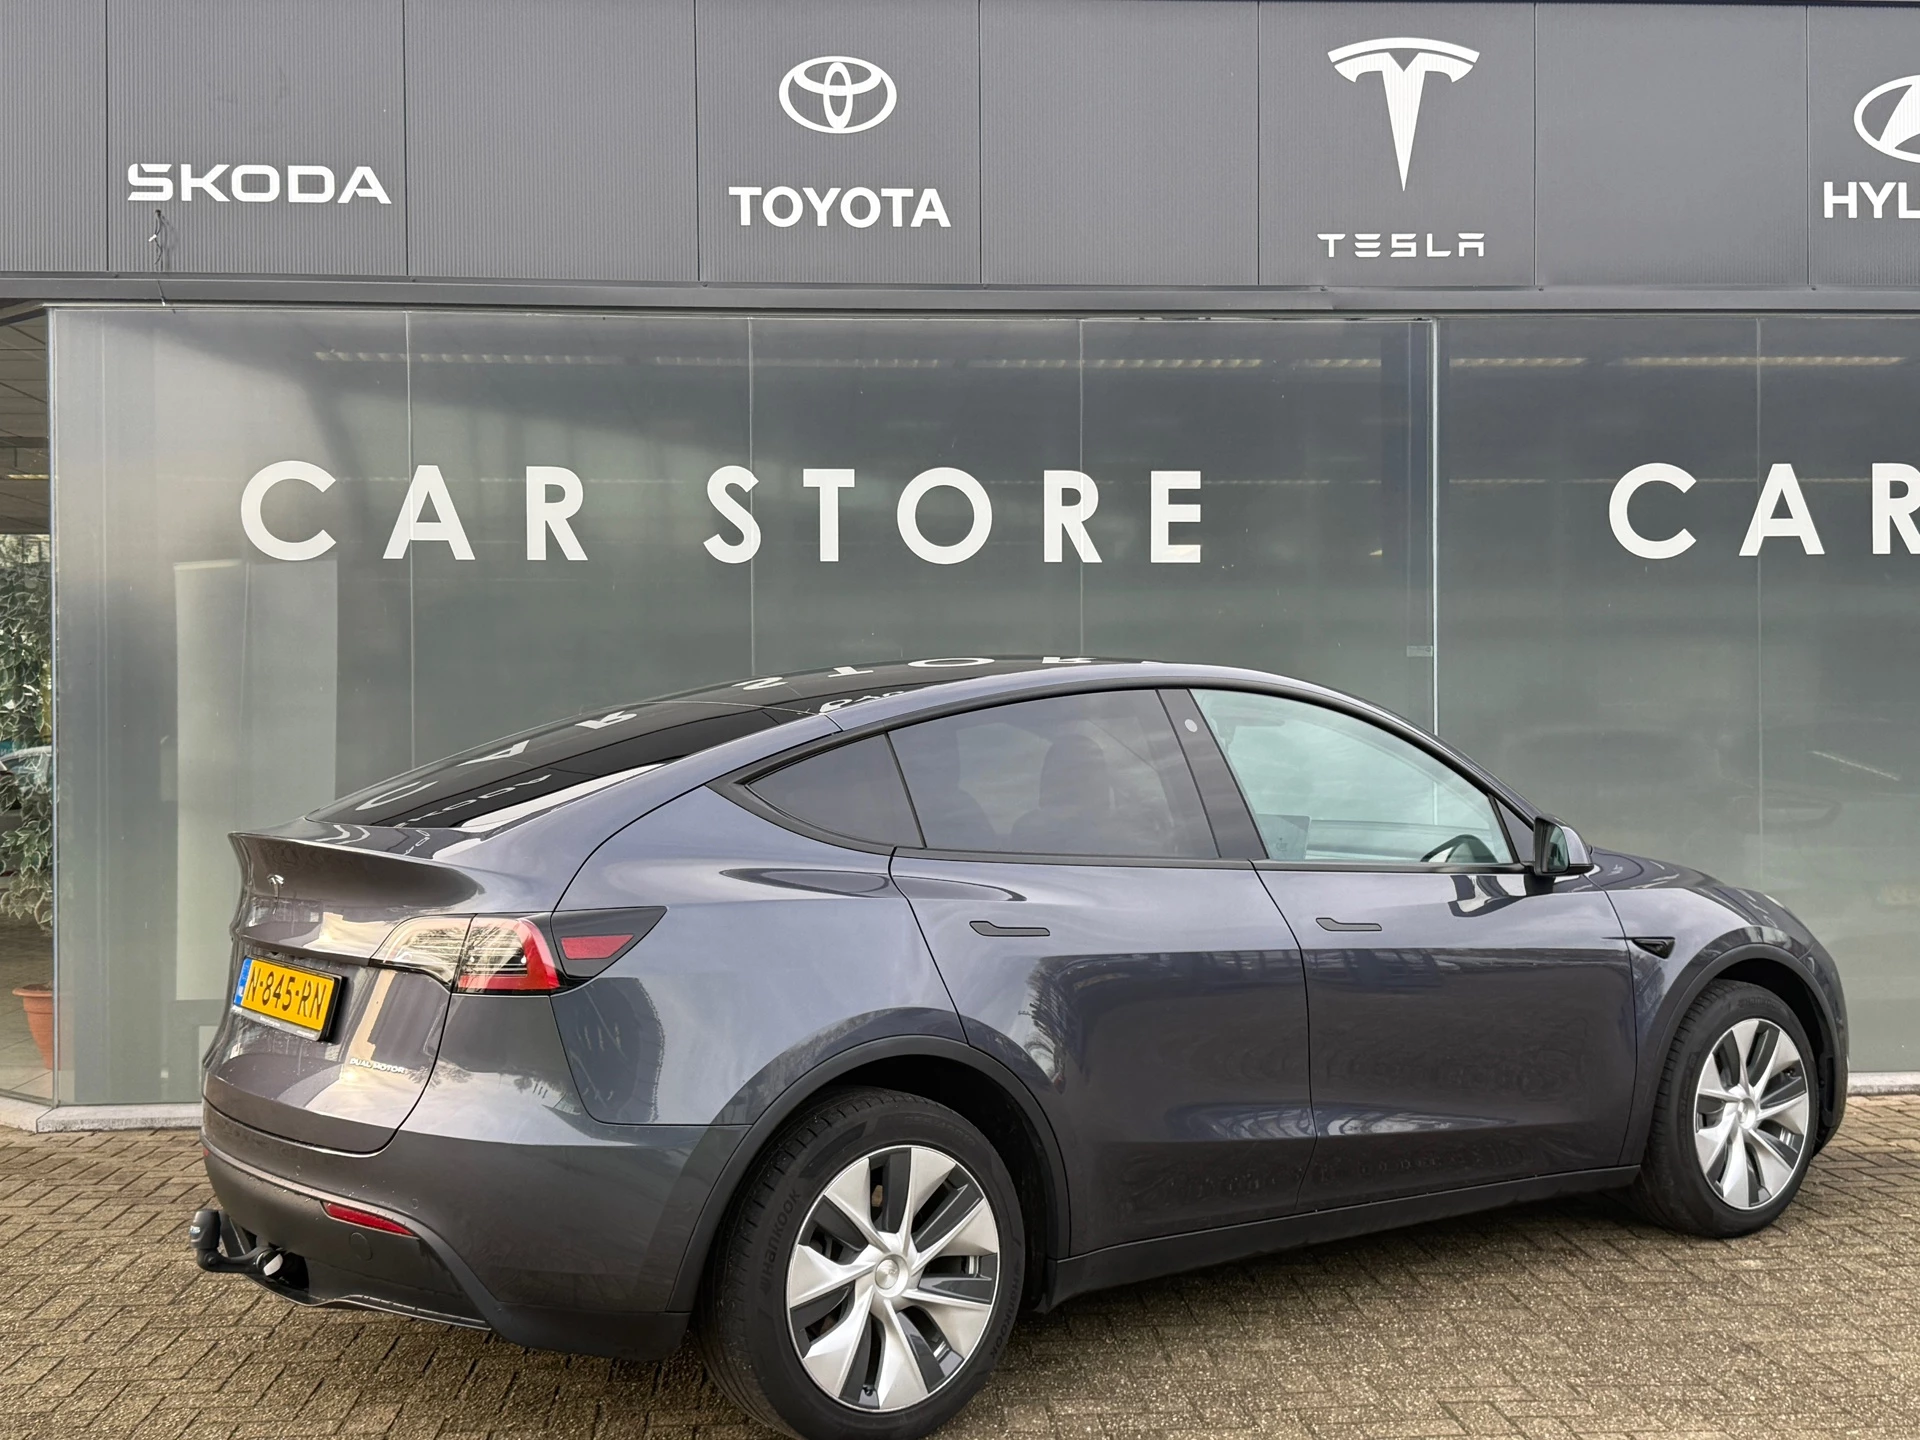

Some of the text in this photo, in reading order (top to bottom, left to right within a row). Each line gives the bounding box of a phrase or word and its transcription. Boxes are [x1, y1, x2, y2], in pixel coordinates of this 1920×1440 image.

[127, 163, 392, 205] SKODA
[728, 185, 952, 229] TOYOTA
[1316, 232, 1485, 258] TESLA
[240, 460, 1202, 565] CAR STORE
[1608, 462, 1920, 560] CAR
[245, 966, 327, 1020] N-845-RN
[350, 1057, 405, 1074] DUAL MOTOR
